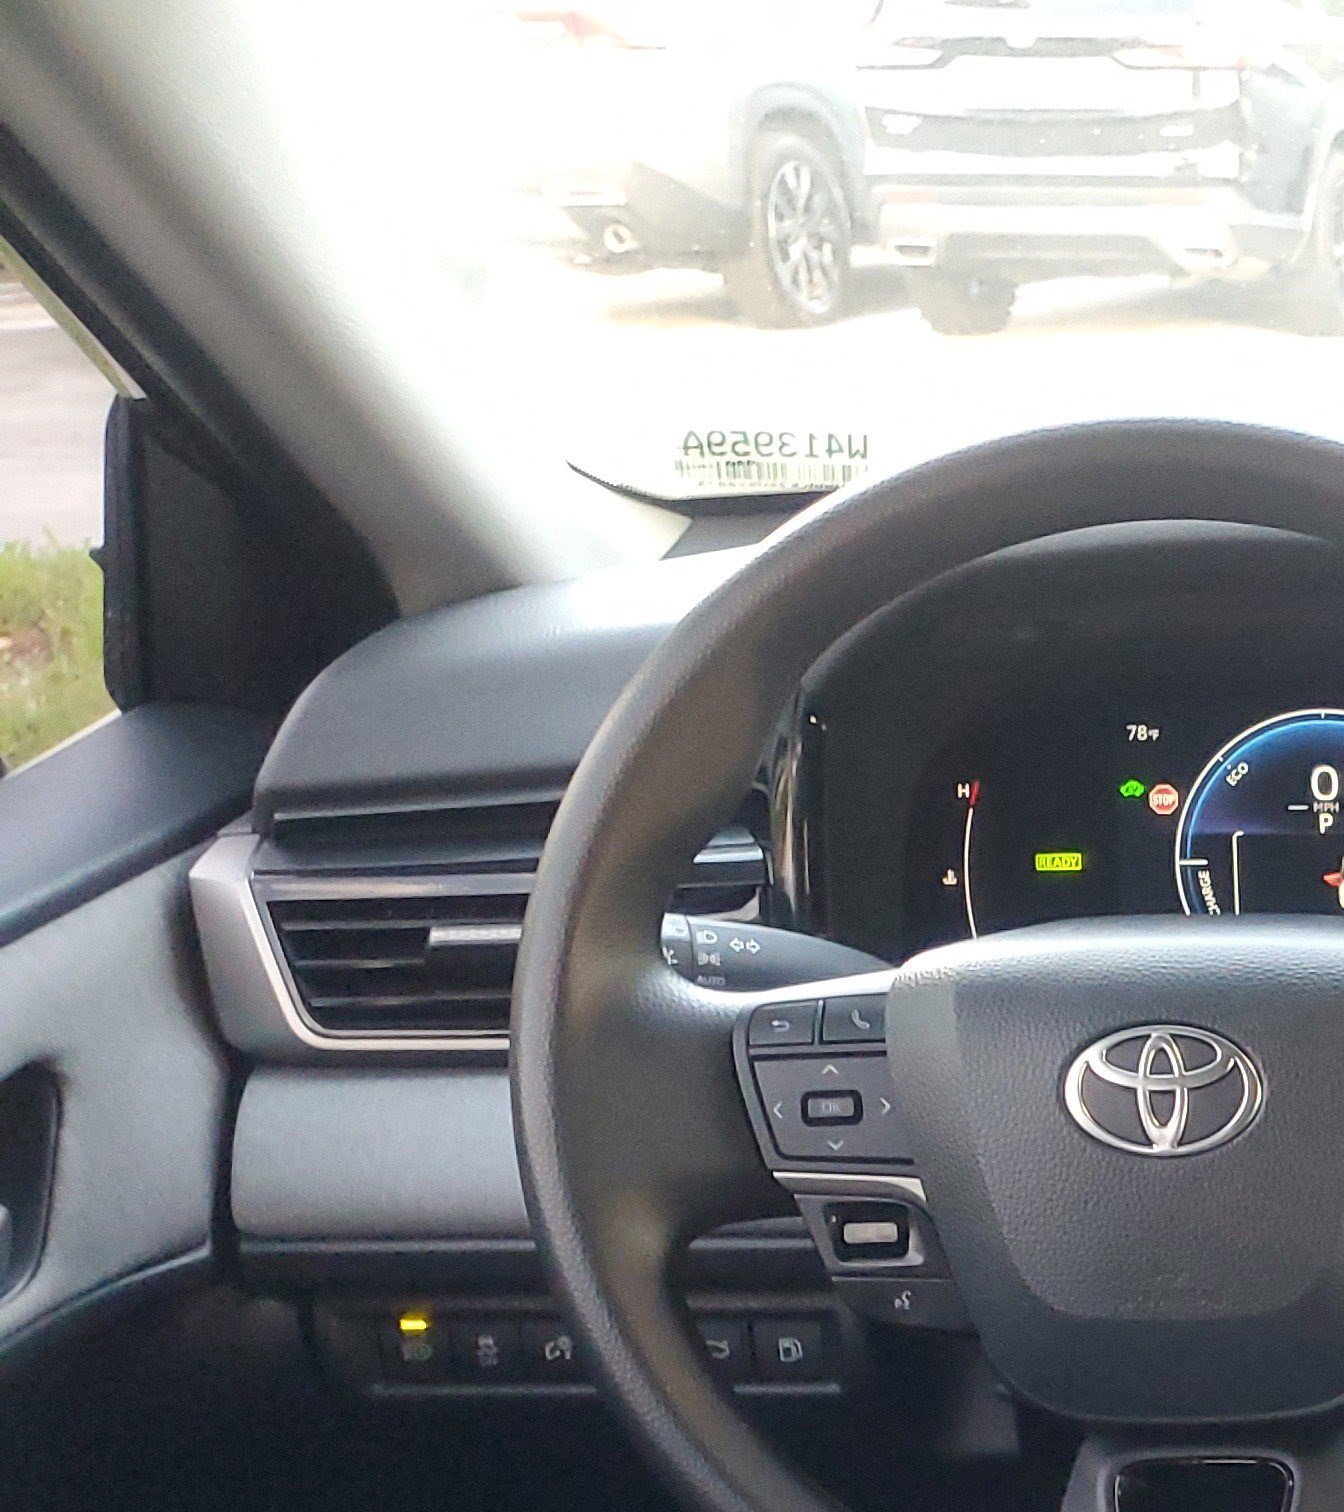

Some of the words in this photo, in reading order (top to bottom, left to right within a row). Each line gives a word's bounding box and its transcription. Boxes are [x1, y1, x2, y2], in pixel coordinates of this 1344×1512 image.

[1225, 761, 1249, 787] ECO
[1310, 764, 1339, 801] 0
[957, 782, 970, 799] H
[1151, 793, 1177, 807] STOP
[1318, 812, 1334, 835] P
[1038, 856, 1079, 868] READY
